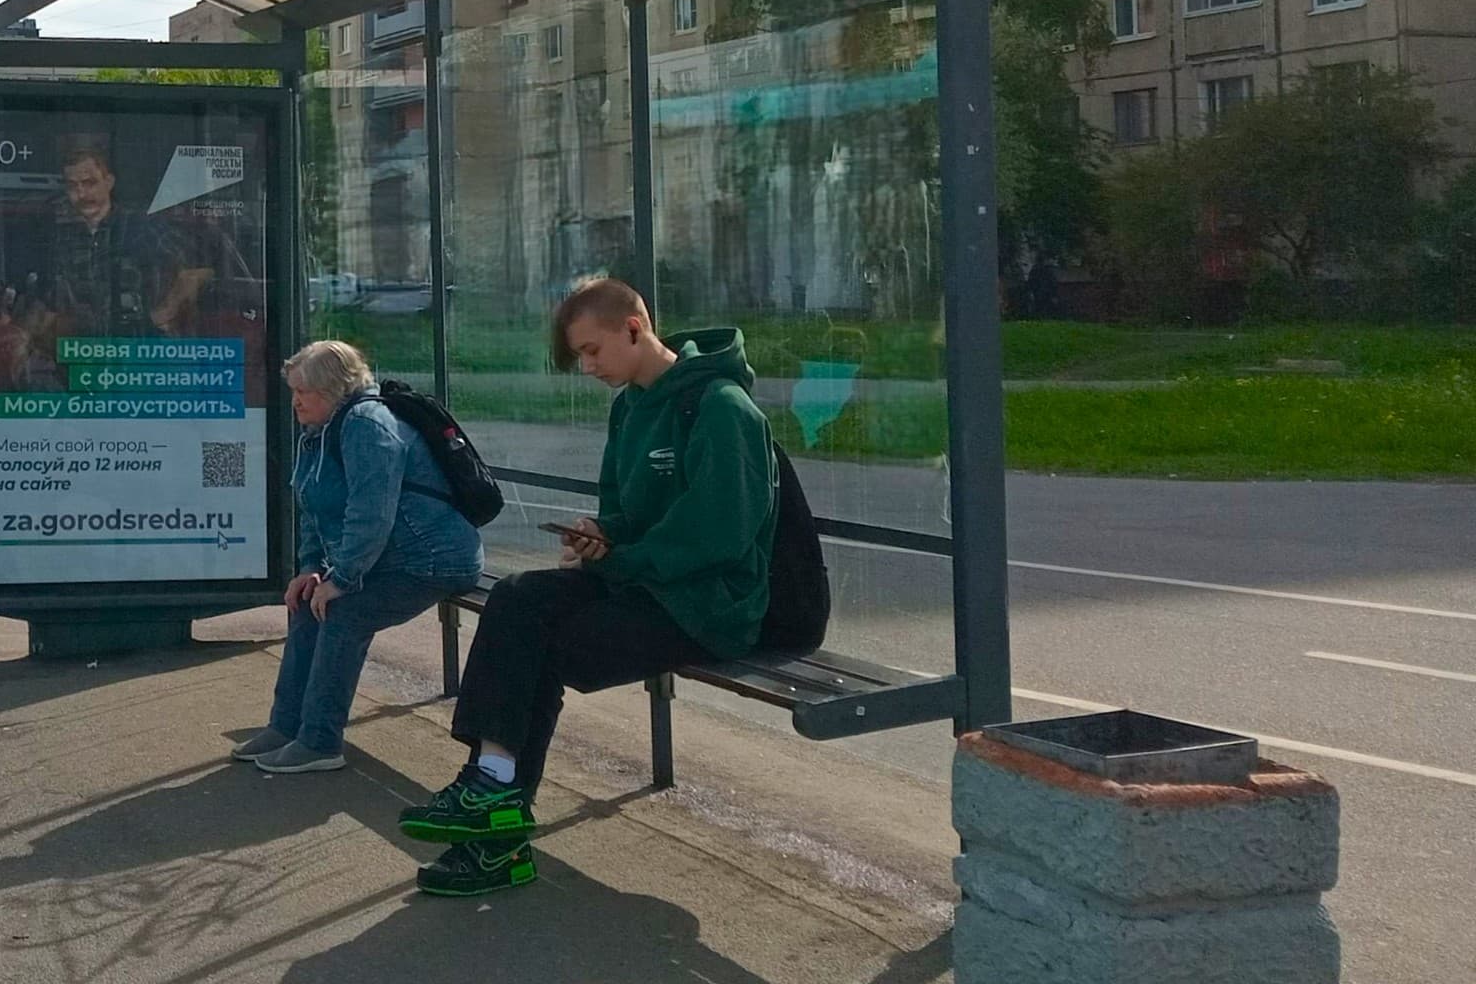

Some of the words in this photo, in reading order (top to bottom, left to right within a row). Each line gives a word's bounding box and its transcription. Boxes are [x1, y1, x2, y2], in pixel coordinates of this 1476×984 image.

[178, 147, 241, 158] НАЦИОНАЛЬНЫЕ
[206, 158, 241, 168] ПРОЕКТЫ
[211, 169, 242, 179] РОССИИ
[64, 340, 130, 358] Новая
[137, 343, 236, 361] площадь
[80, 372, 92, 386] с
[97, 367, 235, 390] фонтанами?
[4, 396, 62, 417] Могу
[67, 395, 237, 417] благоустроить.
[55, 438, 95, 453] свой
[99, 440, 148, 455] город
[67, 460, 91, 473] до
[95, 457, 111, 471] 12
[114, 460, 162, 472] июня
[20, 476, 72, 491] сайте
[3, 508, 234, 537] za.gorodsreda.ru
